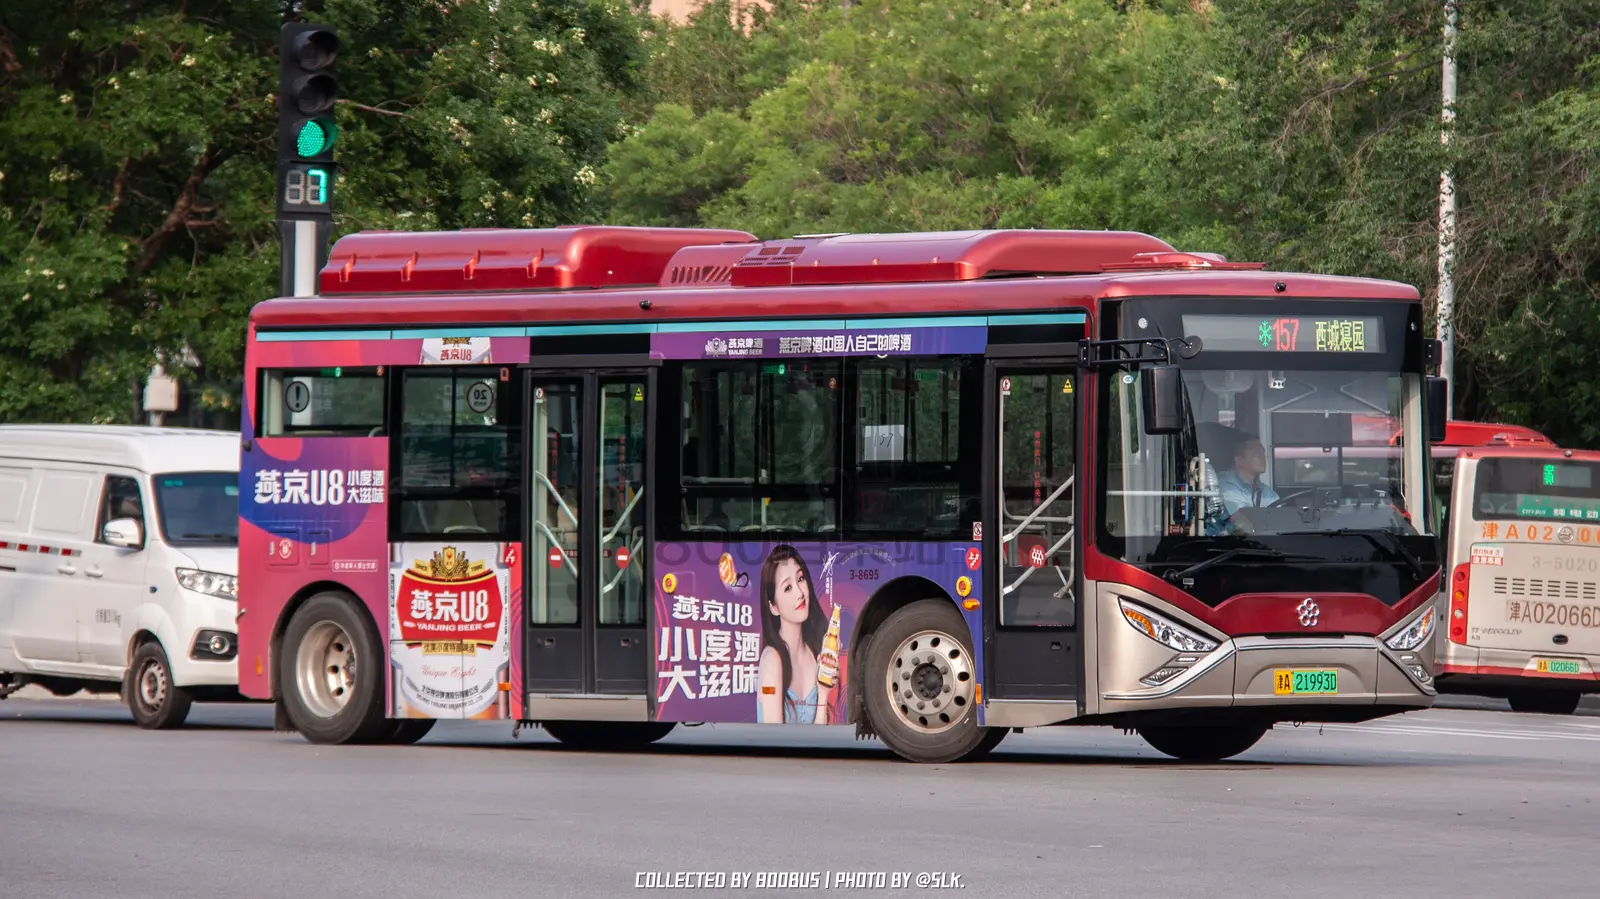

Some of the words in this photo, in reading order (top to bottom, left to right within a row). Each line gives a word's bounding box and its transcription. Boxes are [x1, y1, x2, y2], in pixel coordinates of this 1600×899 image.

[728, 338, 763, 349] 燕京啤酒
[779, 334, 911, 354] 燕京啤酒中国人自己的啤酒
[1273, 318, 1299, 351] 157
[1315, 319, 1365, 351] 西城寝园
[440, 348, 472, 361] 燕京U8
[254, 469, 344, 505] 燕京U8
[347, 470, 384, 486] 小度酒
[347, 488, 384, 503] 大滋味
[850, 569, 879, 580] 3-8695
[410, 589, 488, 623] 燕京U8
[672, 595, 752, 626] 燕京U8
[417, 622, 456, 632] YANJING
[457, 623, 482, 632] BEER
[658, 626, 760, 662] 小度酒
[658, 664, 759, 703] 大滋味
